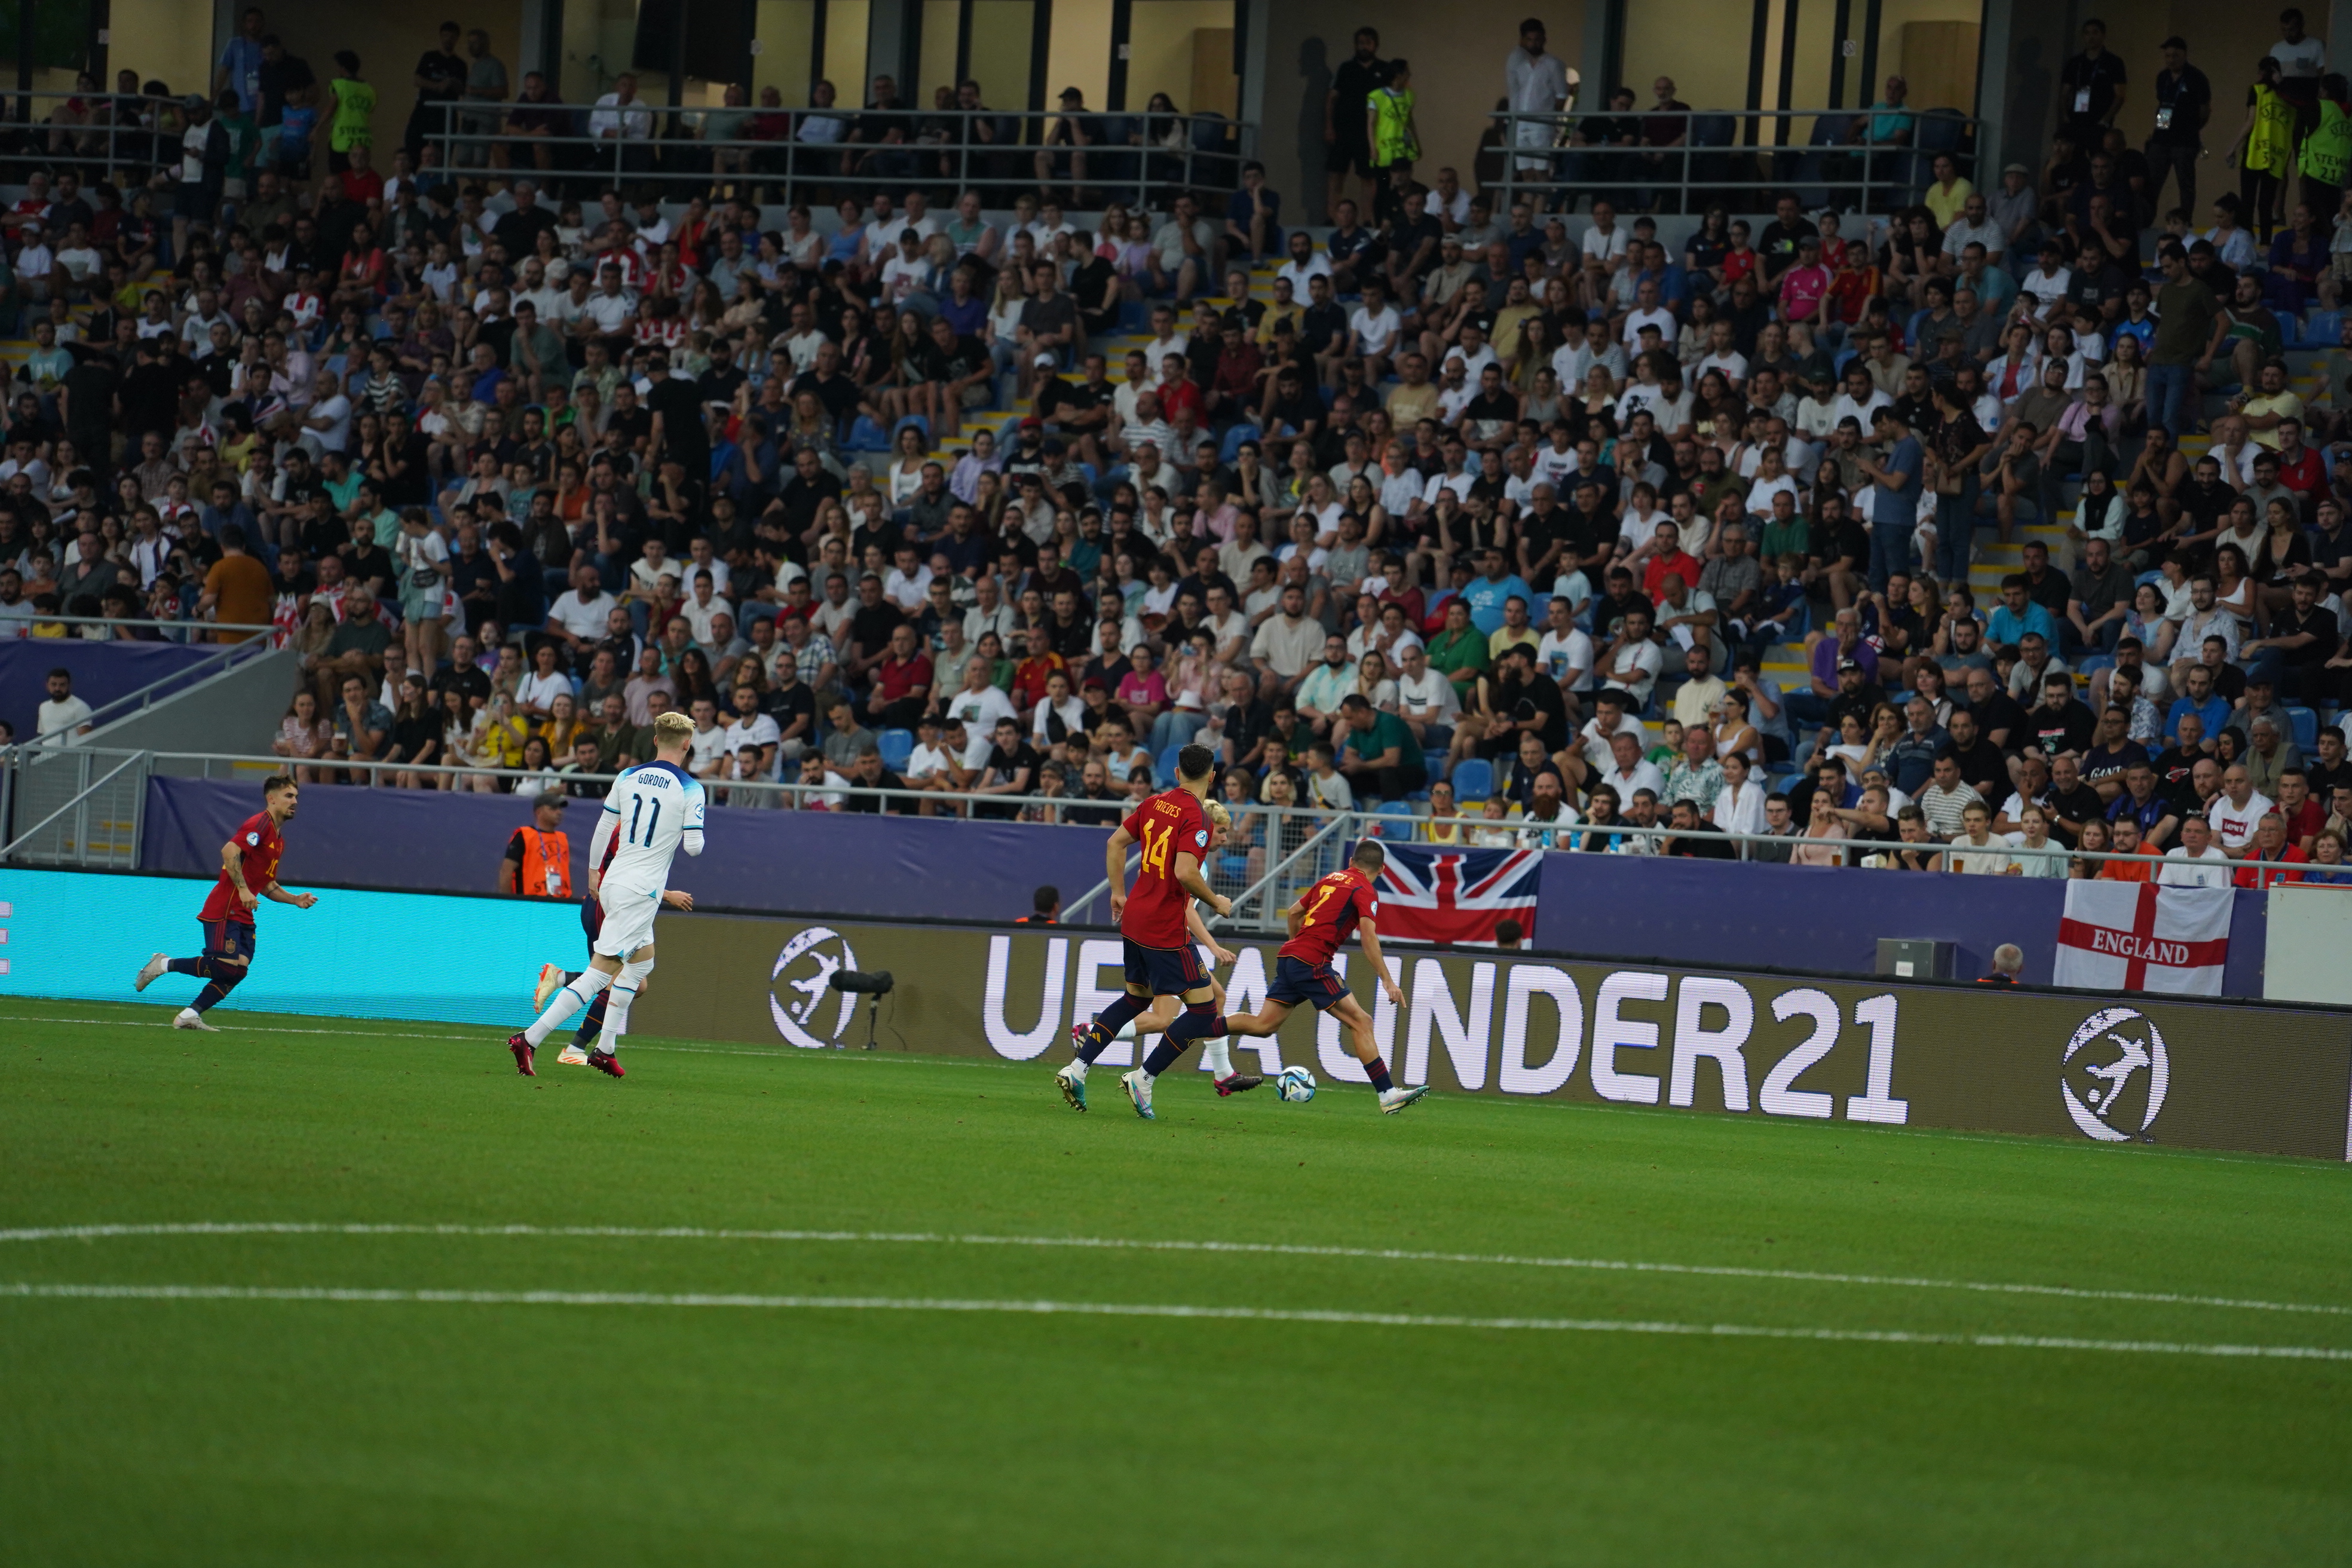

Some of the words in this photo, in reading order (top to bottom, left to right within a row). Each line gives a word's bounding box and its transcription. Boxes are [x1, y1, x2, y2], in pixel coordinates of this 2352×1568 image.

[638, 773, 671, 789] GORDON
[629, 793, 661, 848] 11
[1142, 819, 1174, 880] 14
[2092, 929, 2189, 964] ENGLAND
[1316, 953, 1909, 1125] UNDER21
